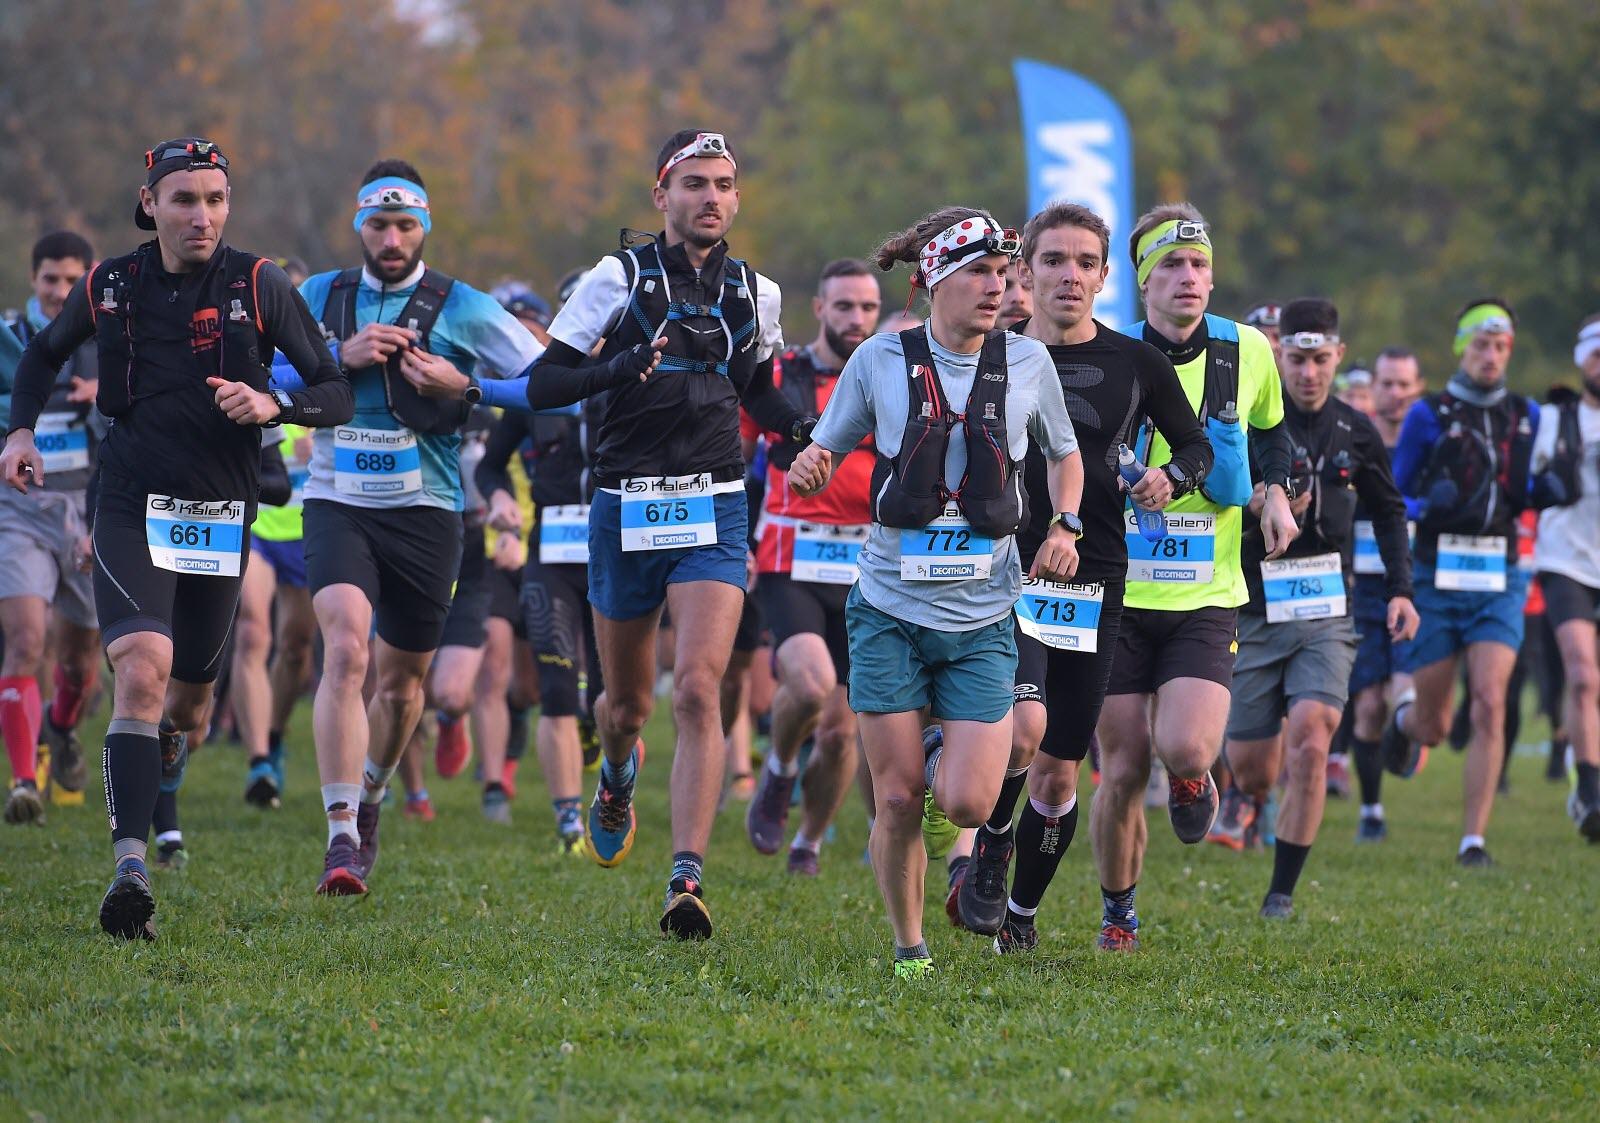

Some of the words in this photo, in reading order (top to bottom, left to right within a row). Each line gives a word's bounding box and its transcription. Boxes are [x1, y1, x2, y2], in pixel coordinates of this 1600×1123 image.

[360, 431, 413, 445] Kalenji
[356, 452, 396, 471] 689
[651, 478, 708, 492] Kalenji
[179, 503, 240, 519] Kalenji
[645, 502, 689, 522] 675
[1163, 516, 1213, 531] alenji
[169, 524, 212, 546] 661
[654, 535, 695, 544] DECATHLON
[924, 529, 971, 551] 772
[1151, 538, 1189, 557] 781
[177, 559, 217, 570] DECATHLON
[932, 567, 972, 575] DECATHLON
[1287, 578, 1323, 597] 783
[1034, 599, 1076, 622] 713
[1039, 826, 1051, 853] COMPRE
[1047, 832, 1060, 854] SPORT
